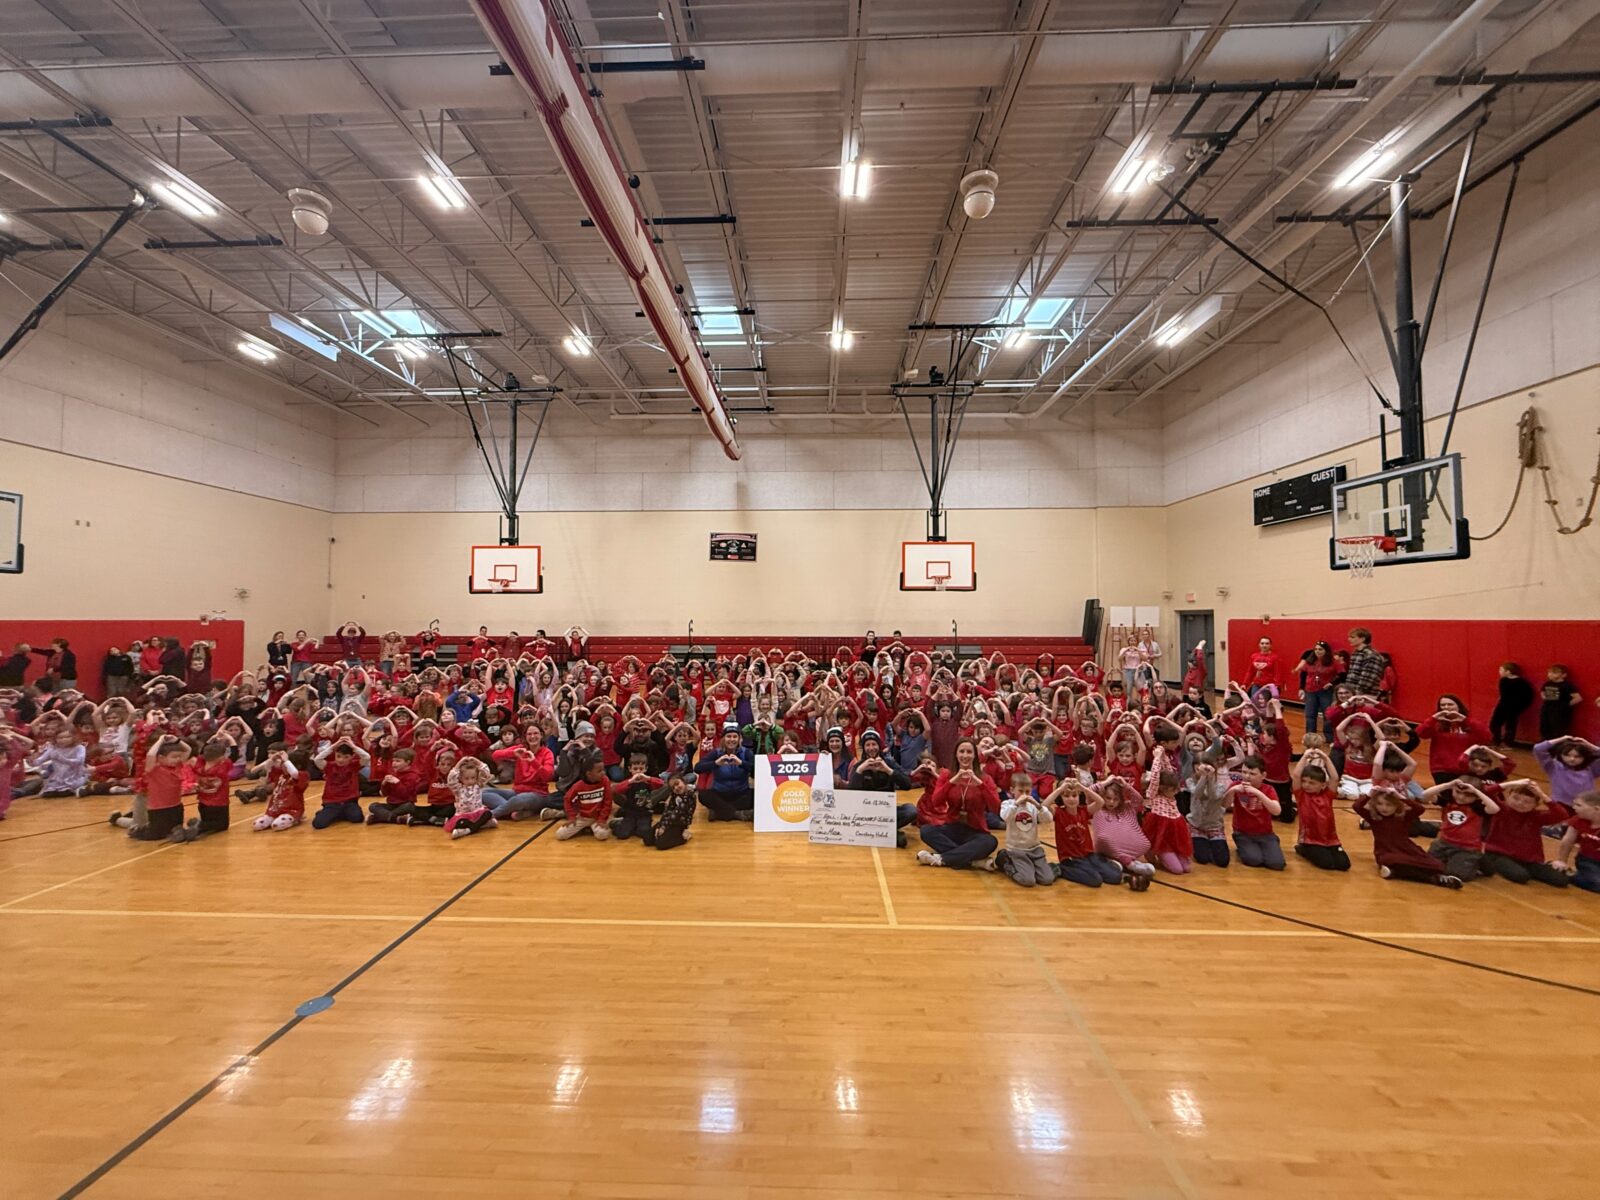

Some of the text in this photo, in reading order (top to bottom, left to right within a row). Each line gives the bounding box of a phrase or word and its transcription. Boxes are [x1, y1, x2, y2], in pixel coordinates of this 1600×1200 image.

[1254, 468, 1335, 498] HOME GUEST
[778, 764, 809, 774] 2026
